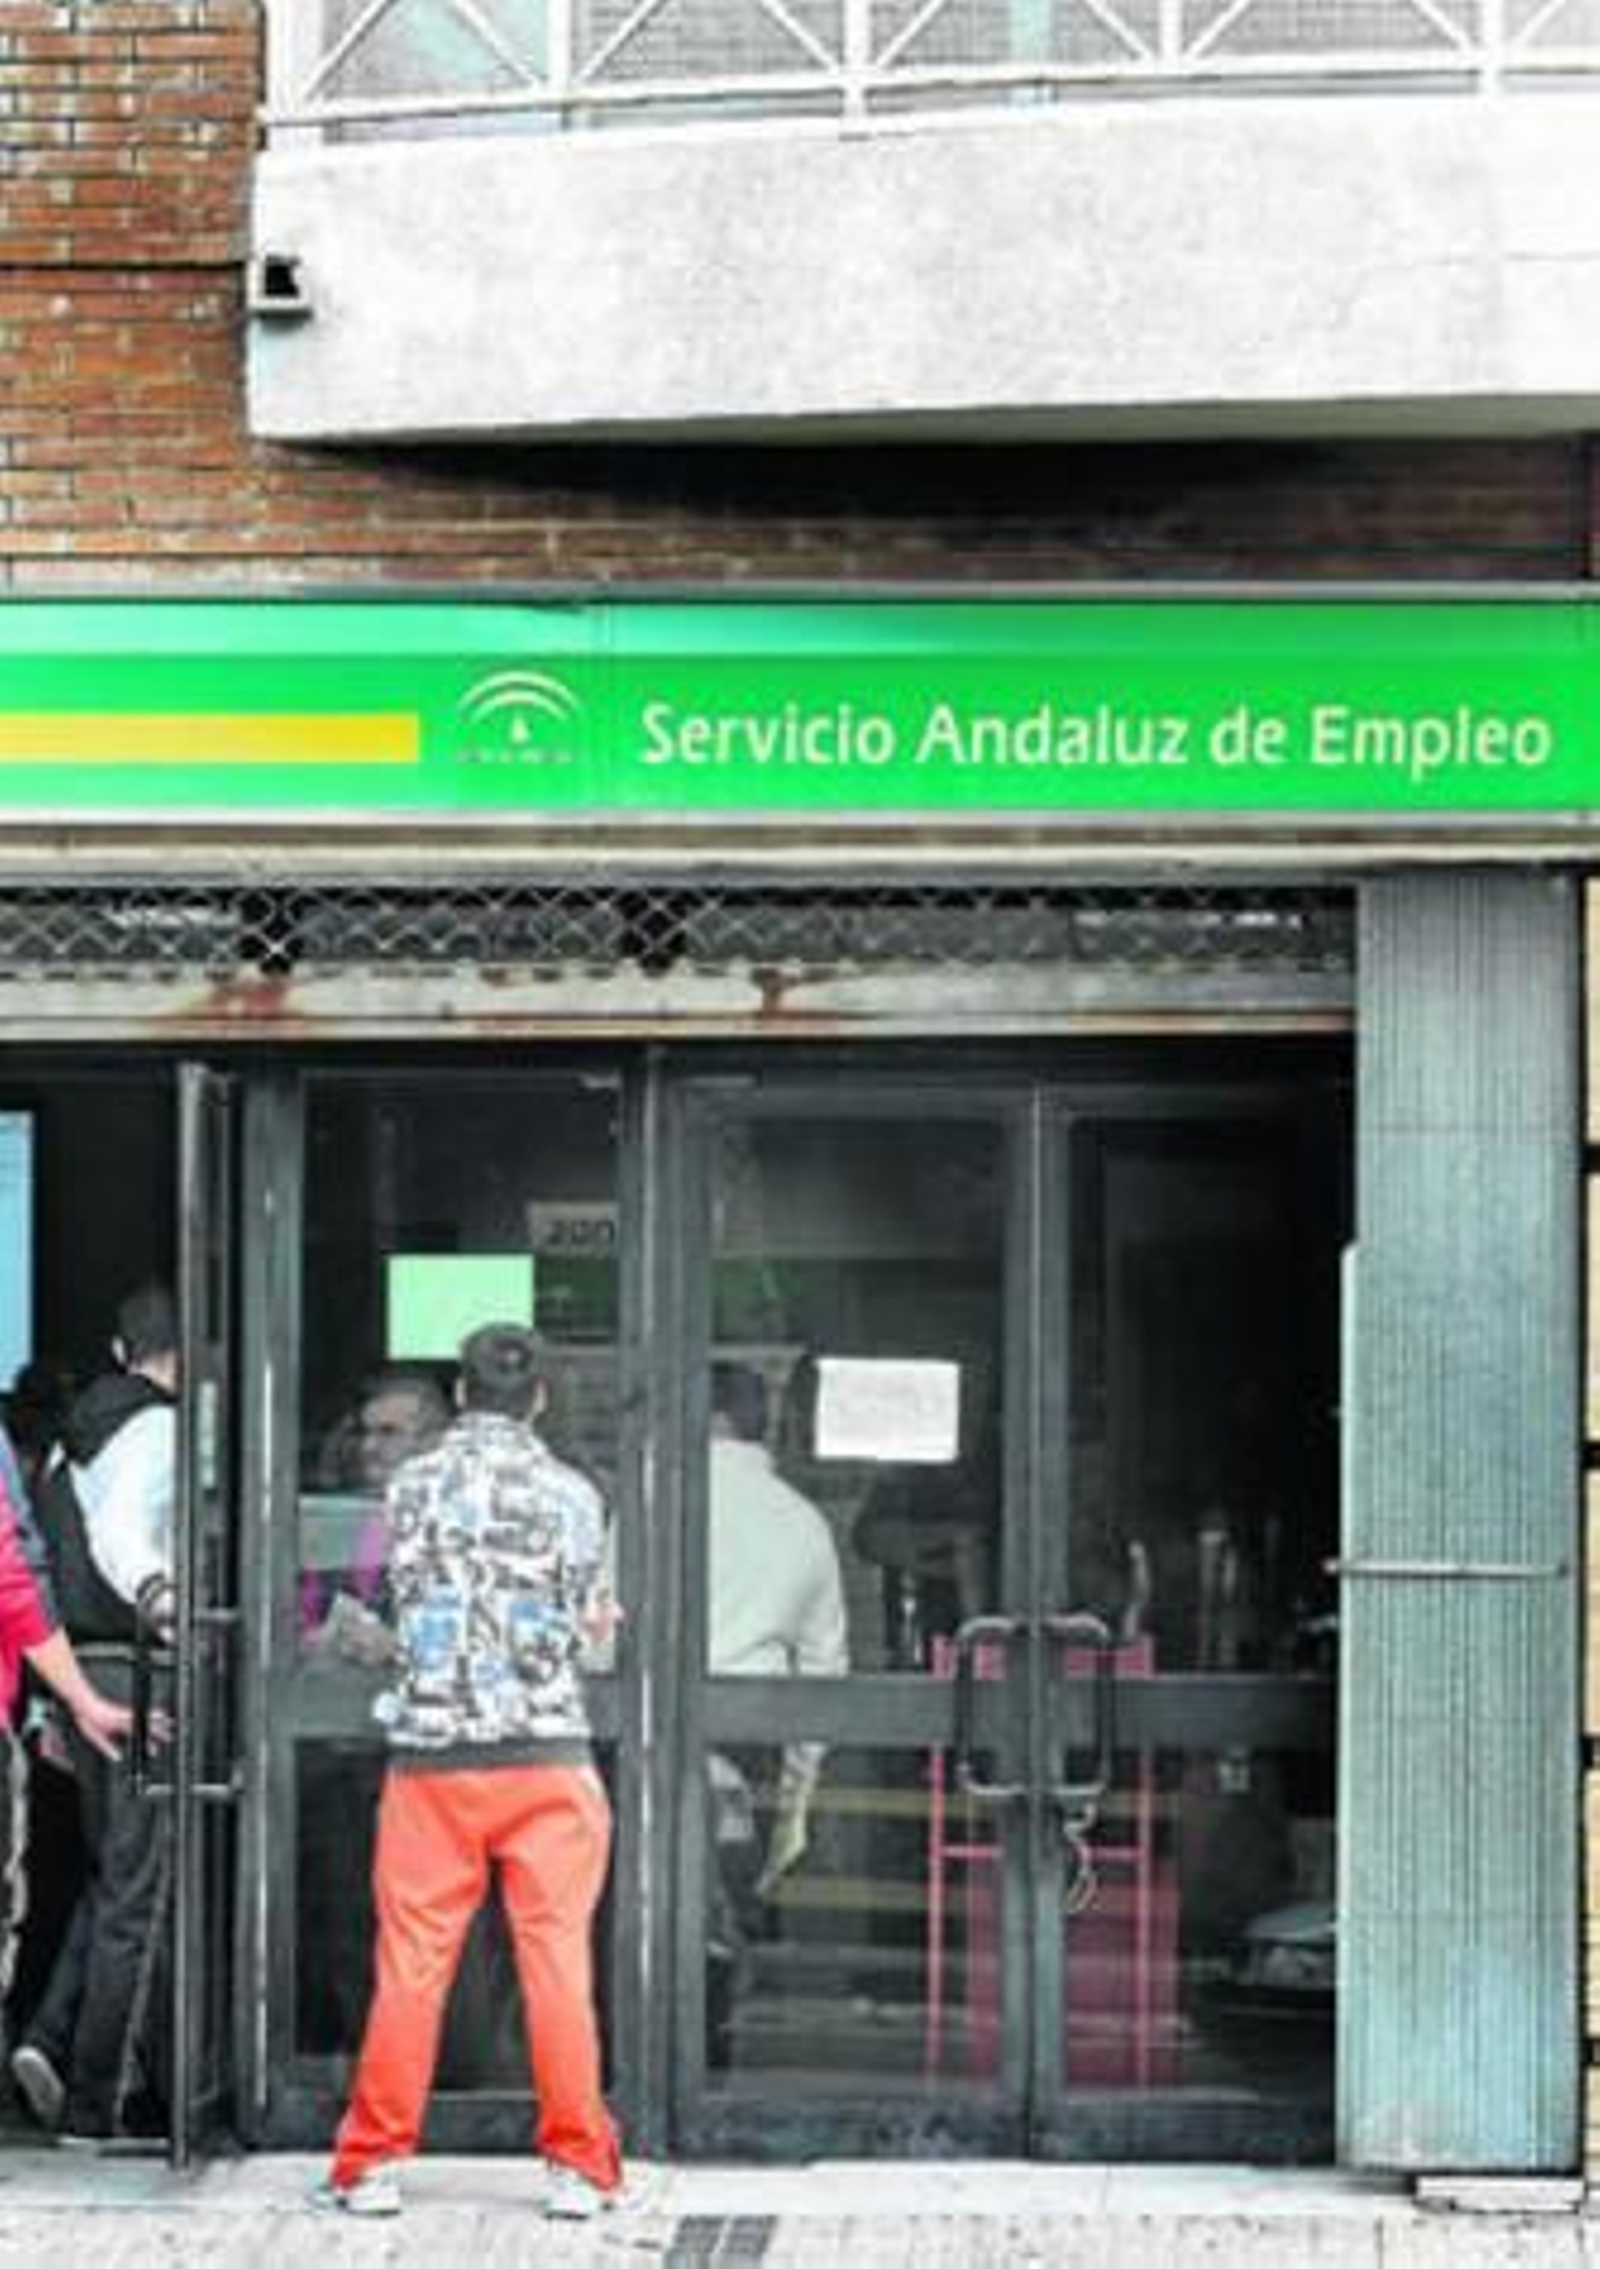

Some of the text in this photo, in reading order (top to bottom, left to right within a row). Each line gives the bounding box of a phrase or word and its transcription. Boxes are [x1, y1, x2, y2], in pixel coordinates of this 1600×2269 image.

[641, 704, 1551, 781] Servicio Andaluz de Empleo
